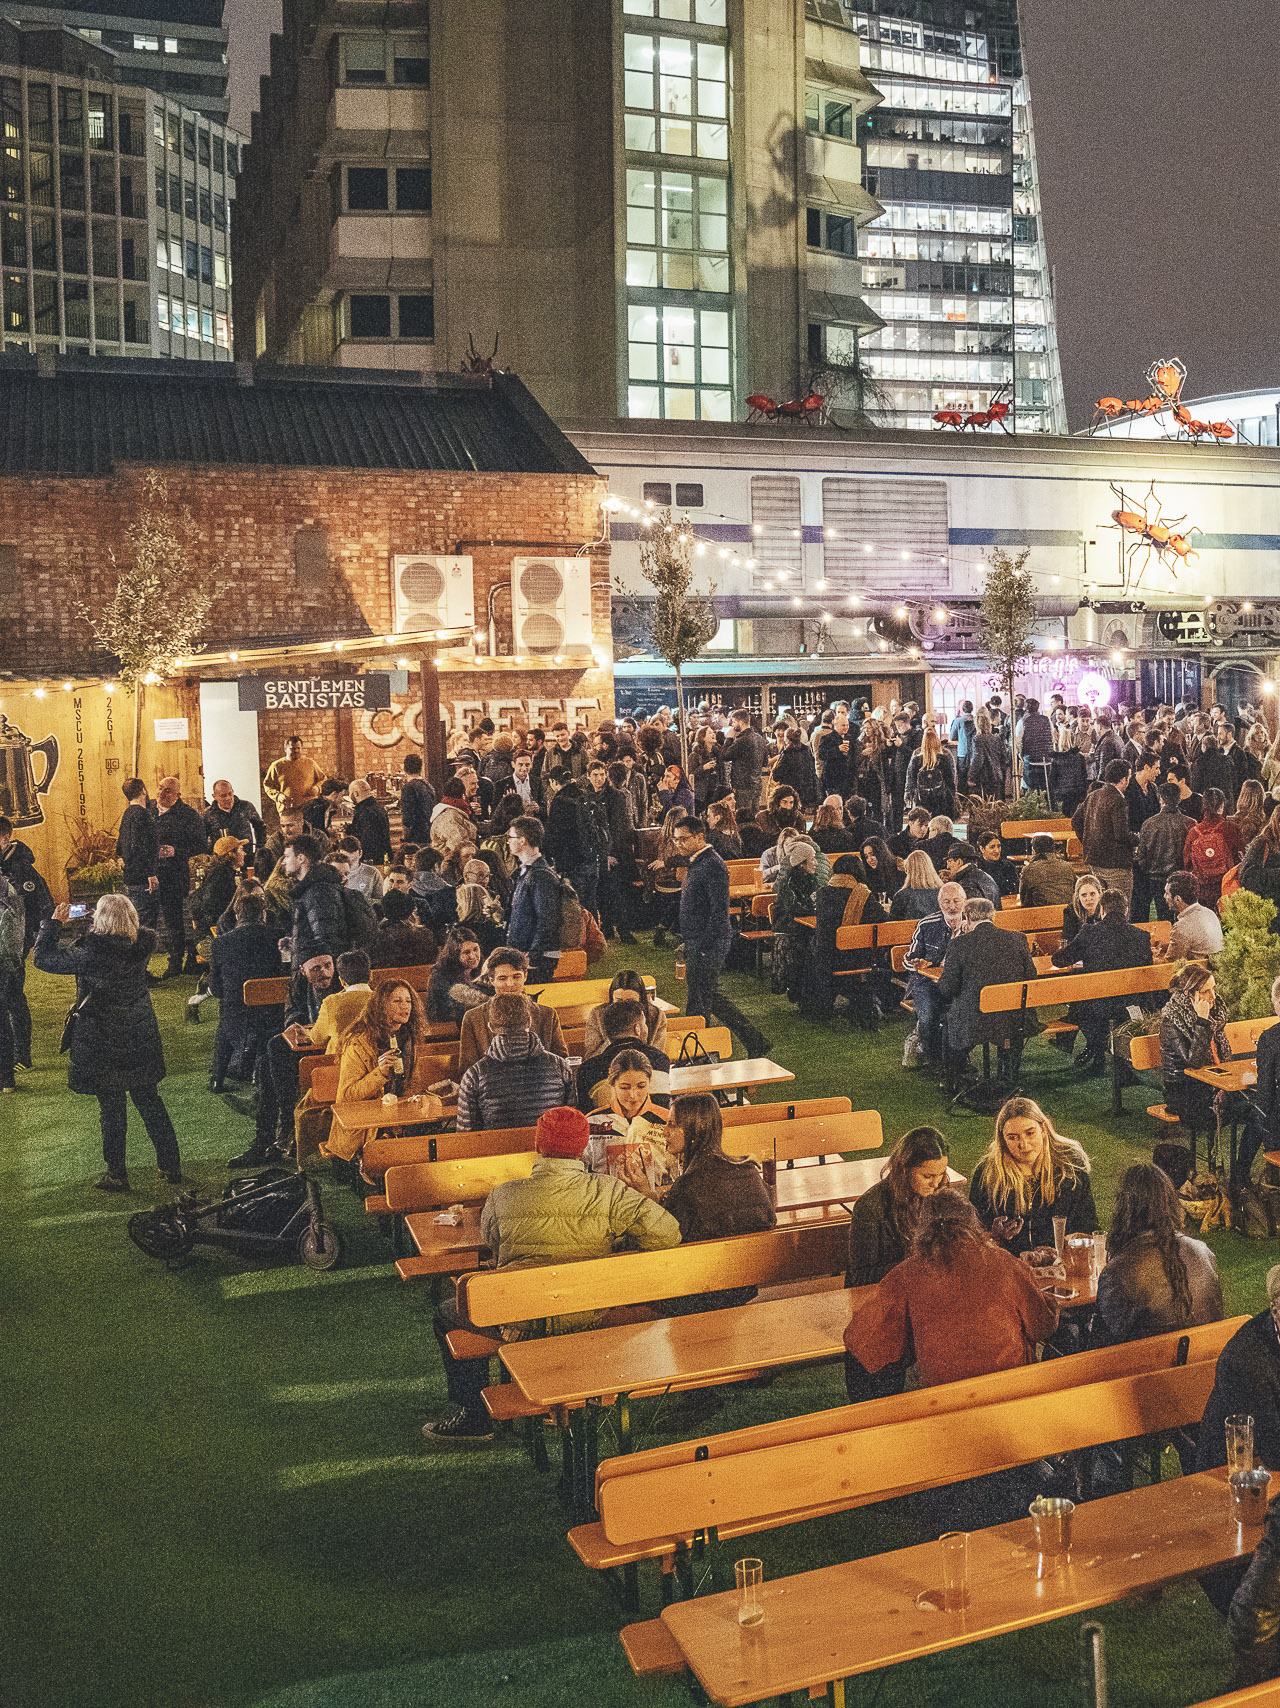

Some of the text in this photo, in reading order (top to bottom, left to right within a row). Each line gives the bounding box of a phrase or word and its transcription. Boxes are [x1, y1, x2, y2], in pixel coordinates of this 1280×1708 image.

[264, 680, 365, 693] GENTLEMEN
[265, 692, 365, 709] BARISTAS
[73, 697, 83, 744] MSCU
